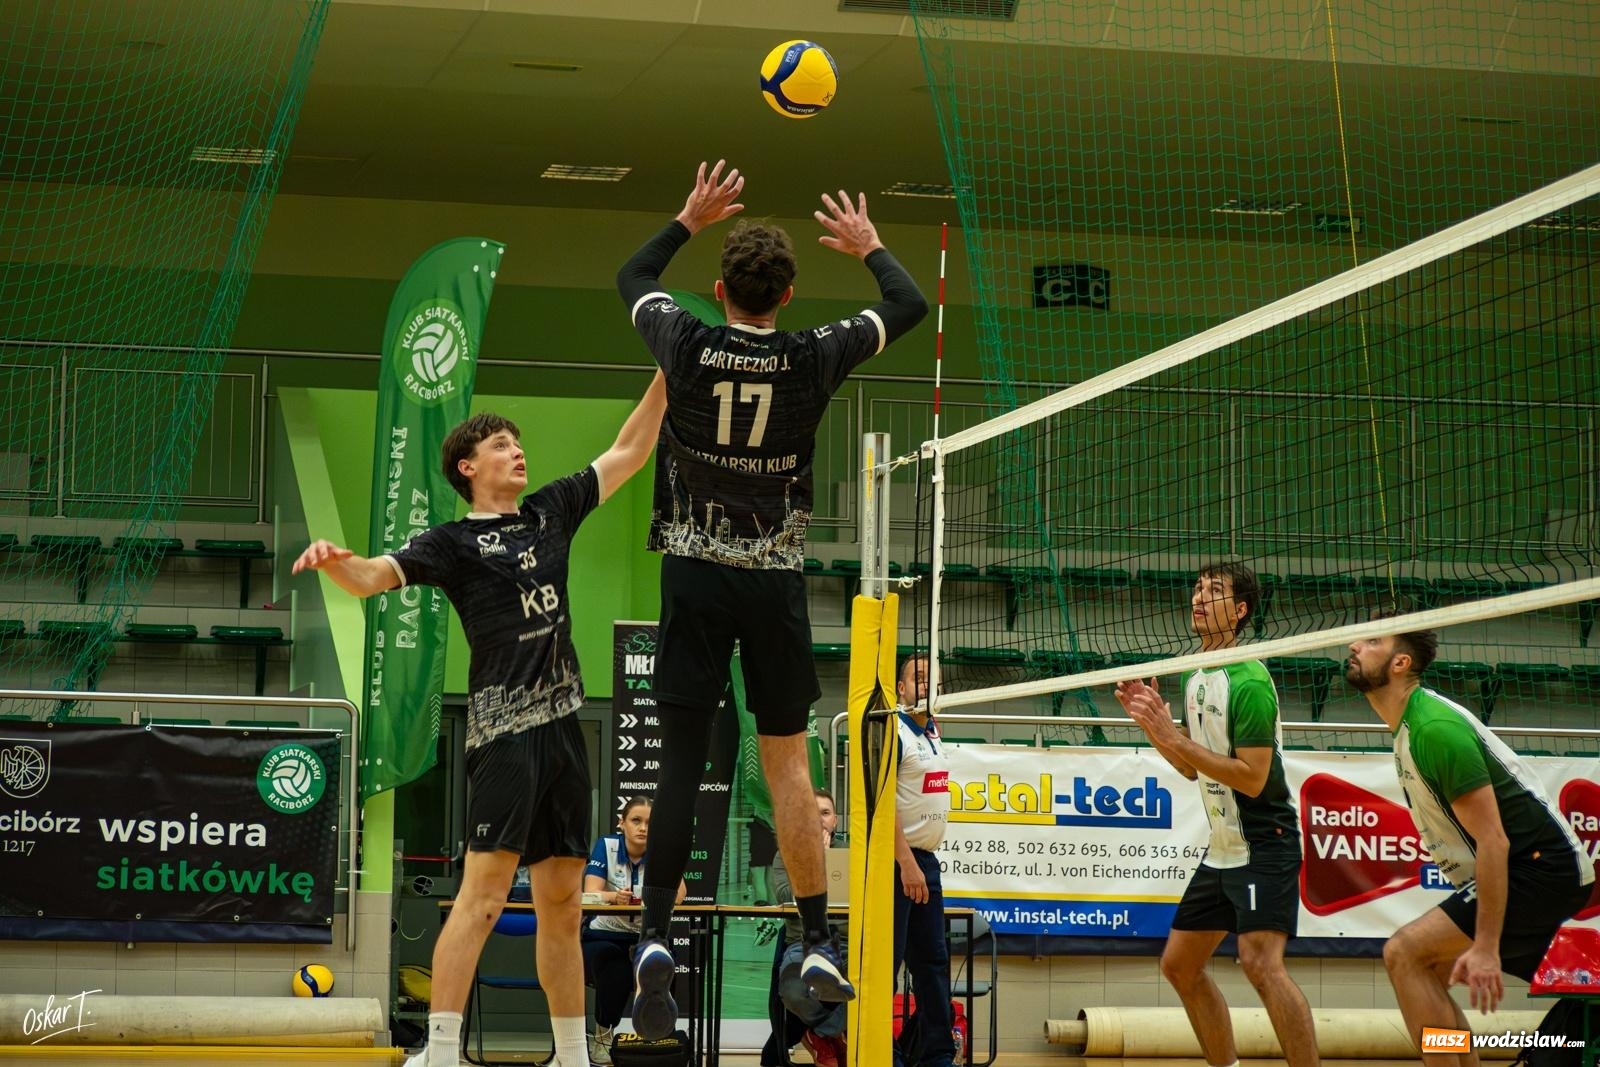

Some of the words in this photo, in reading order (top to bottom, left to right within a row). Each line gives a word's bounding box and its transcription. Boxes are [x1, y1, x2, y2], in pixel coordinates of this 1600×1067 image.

[402, 314, 424, 349] KLUB
[425, 307, 469, 361] SIATKARSKI
[699, 348, 778, 373] BARTECZKO
[780, 355, 791, 372] J.
[404, 373, 455, 400] RACIBÓRZ
[712, 381, 773, 447] 17
[767, 454, 797, 474] KLUB
[480, 543, 507, 555] radlin
[520, 584, 559, 619] KB
[625, 679, 652, 690] TA
[633, 698, 657, 706] SIATK
[262, 754, 280, 778] KLUB
[279, 748, 321, 780] SIATKARSKI
[268, 793, 315, 809] RACIBÓRZ
[1311, 805, 1379, 827] Radio
[98, 812, 267, 851] wspiera
[3, 840, 36, 857] 1217
[938, 840, 960, 852] 14
[964, 840, 982, 853] 92
[987, 840, 1009, 855] 88,
[1017, 842, 1044, 854] 502
[1049, 842, 1076, 856] 632
[1081, 843, 1111, 858] 695,
[1119, 844, 1146, 858] 606
[1151, 845, 1178, 859] 363
[1183, 846, 1208, 860] 647
[96, 857, 315, 903] siatkówkę
[953, 860, 1020, 877] Racibórz,
[1025, 862, 1042, 876] ul.
[1046, 863, 1057, 877] J.
[1061, 867, 1088, 878] von
[1093, 864, 1186, 880] Eichendorffa
[1248, 883, 1257, 911] 1
[975, 907, 1130, 930] ww.instal-tech.pl
